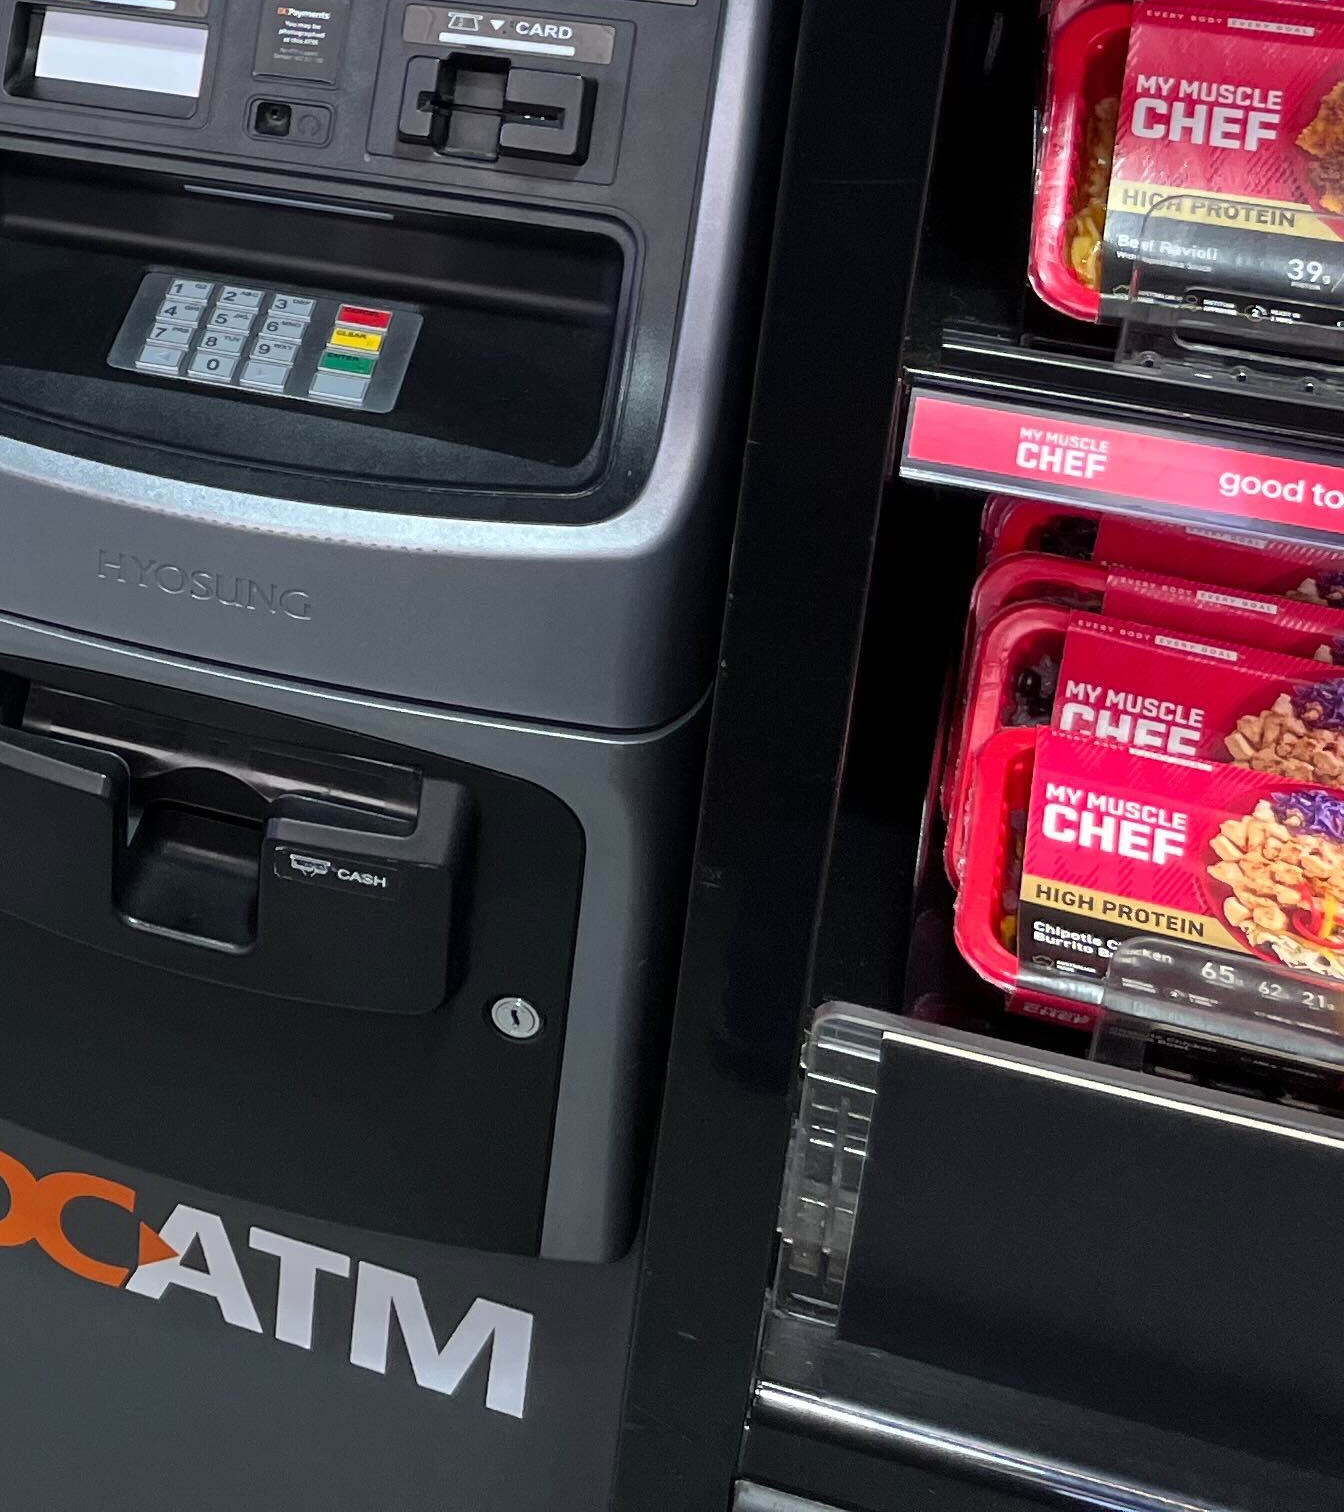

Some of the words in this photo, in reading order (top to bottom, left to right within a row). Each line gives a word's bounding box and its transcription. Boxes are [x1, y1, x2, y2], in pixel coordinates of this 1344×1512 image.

[514, 20, 574, 41] CARD
[1135, 74, 1175, 98] MY
[1178, 79, 1284, 111] MUSCLE
[1131, 97, 1280, 152] CHEF
[1122, 189, 1185, 213] HIGH
[1190, 197, 1297, 229] PROTEIN
[335, 329, 368, 340] CLEAR
[1019, 426, 1046, 443] MY
[1047, 430, 1110, 454] MUSCLE
[1016, 440, 1109, 479] CHEF
[1218, 470, 1305, 505] good
[96, 548, 313, 622] HYOSUNG
[1064, 679, 1104, 705] MY
[1104, 689, 1206, 730] MUSCLE
[1045, 782, 1085, 806] MY
[1086, 791, 1188, 833] MUSCLE
[1042, 803, 1187, 865] CHEF
[335, 865, 388, 889] CASH
[1034, 882, 1095, 913] HIGH
[1102, 899, 1206, 938] PROTEIN
[1033, 920, 1103, 946] Chipotle
[1033, 930, 1094, 955] Burrito
